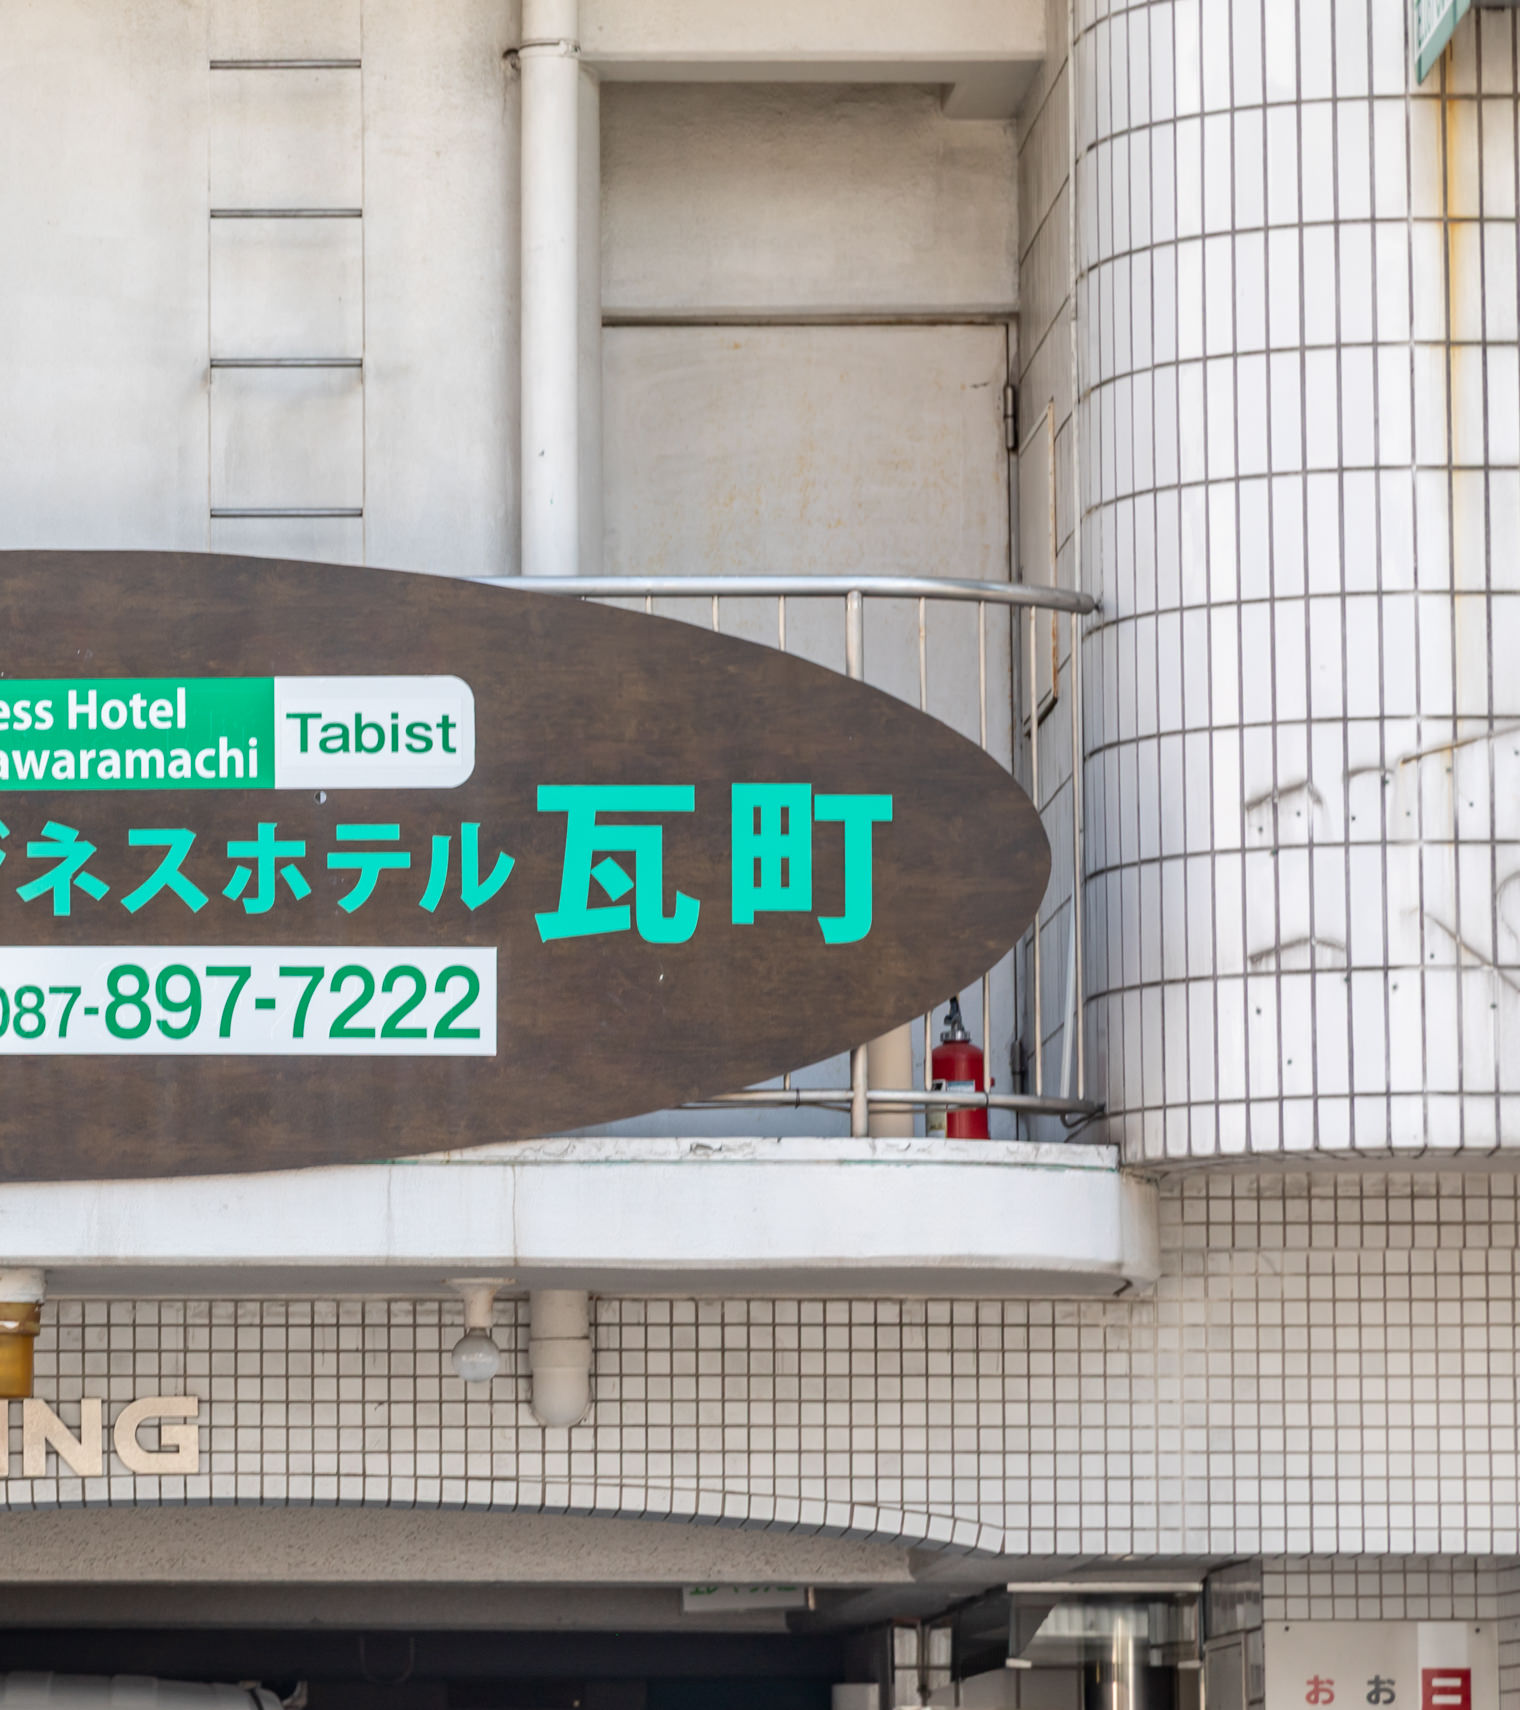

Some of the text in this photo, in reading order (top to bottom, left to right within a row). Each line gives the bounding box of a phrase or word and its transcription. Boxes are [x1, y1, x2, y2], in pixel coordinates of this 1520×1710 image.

[67, 687, 187, 731] Hotel
[285, 711, 458, 755] Tabist
[1305, 1674, 1335, 1705] お
[1366, 1674, 1396, 1705] お
